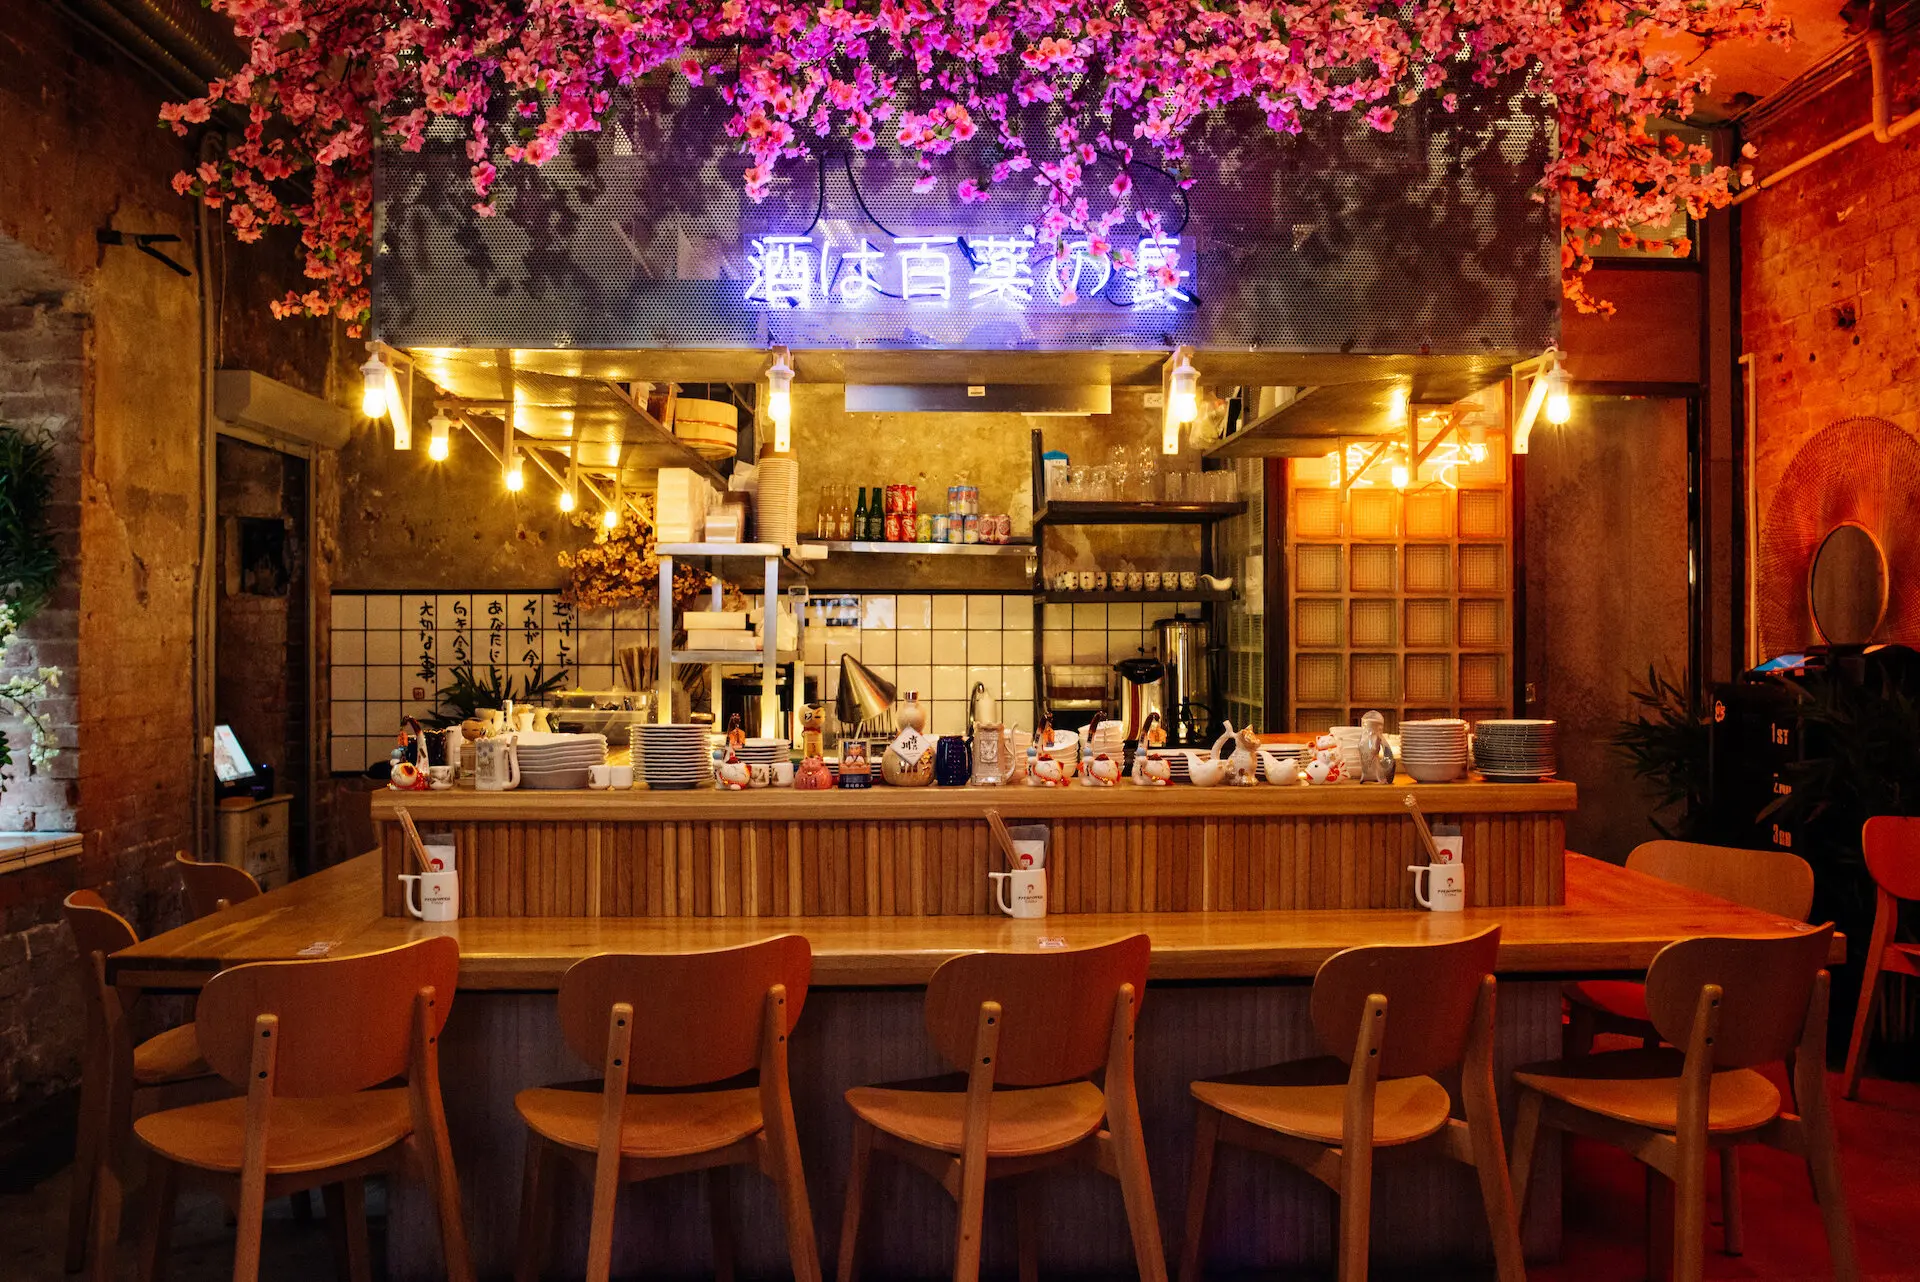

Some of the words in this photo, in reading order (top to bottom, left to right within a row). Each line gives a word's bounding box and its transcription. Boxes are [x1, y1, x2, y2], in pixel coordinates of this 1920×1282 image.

[744, 236, 1190, 305] 酒は百薬の長
[1771, 723, 1789, 745] 1ST
